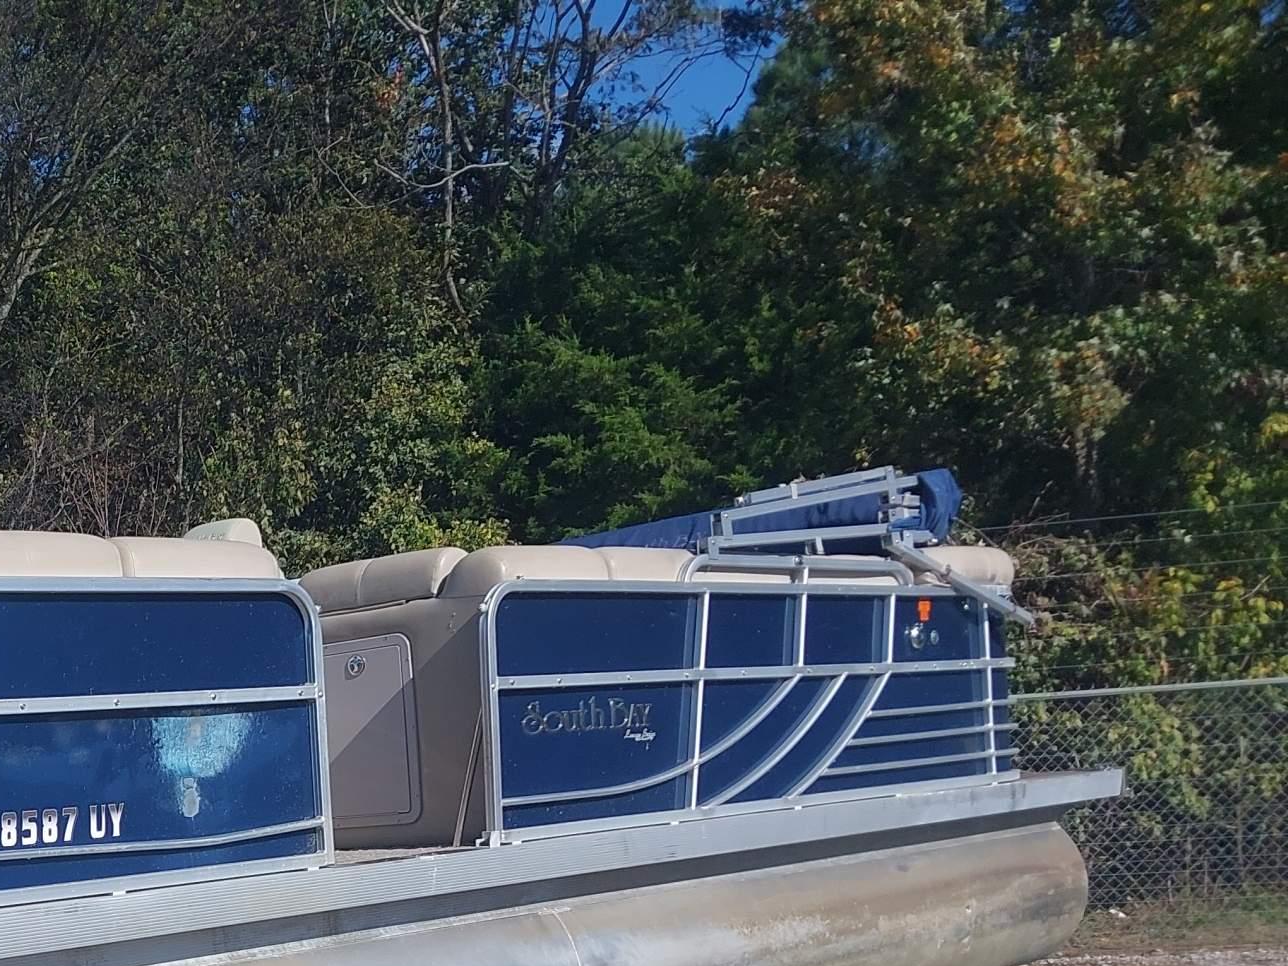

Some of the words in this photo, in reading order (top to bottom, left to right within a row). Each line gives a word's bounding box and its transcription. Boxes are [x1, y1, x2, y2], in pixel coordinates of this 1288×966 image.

[520, 695, 606, 735] South
[0, 806, 78, 848] 8587
[88, 802, 126, 839] UY
